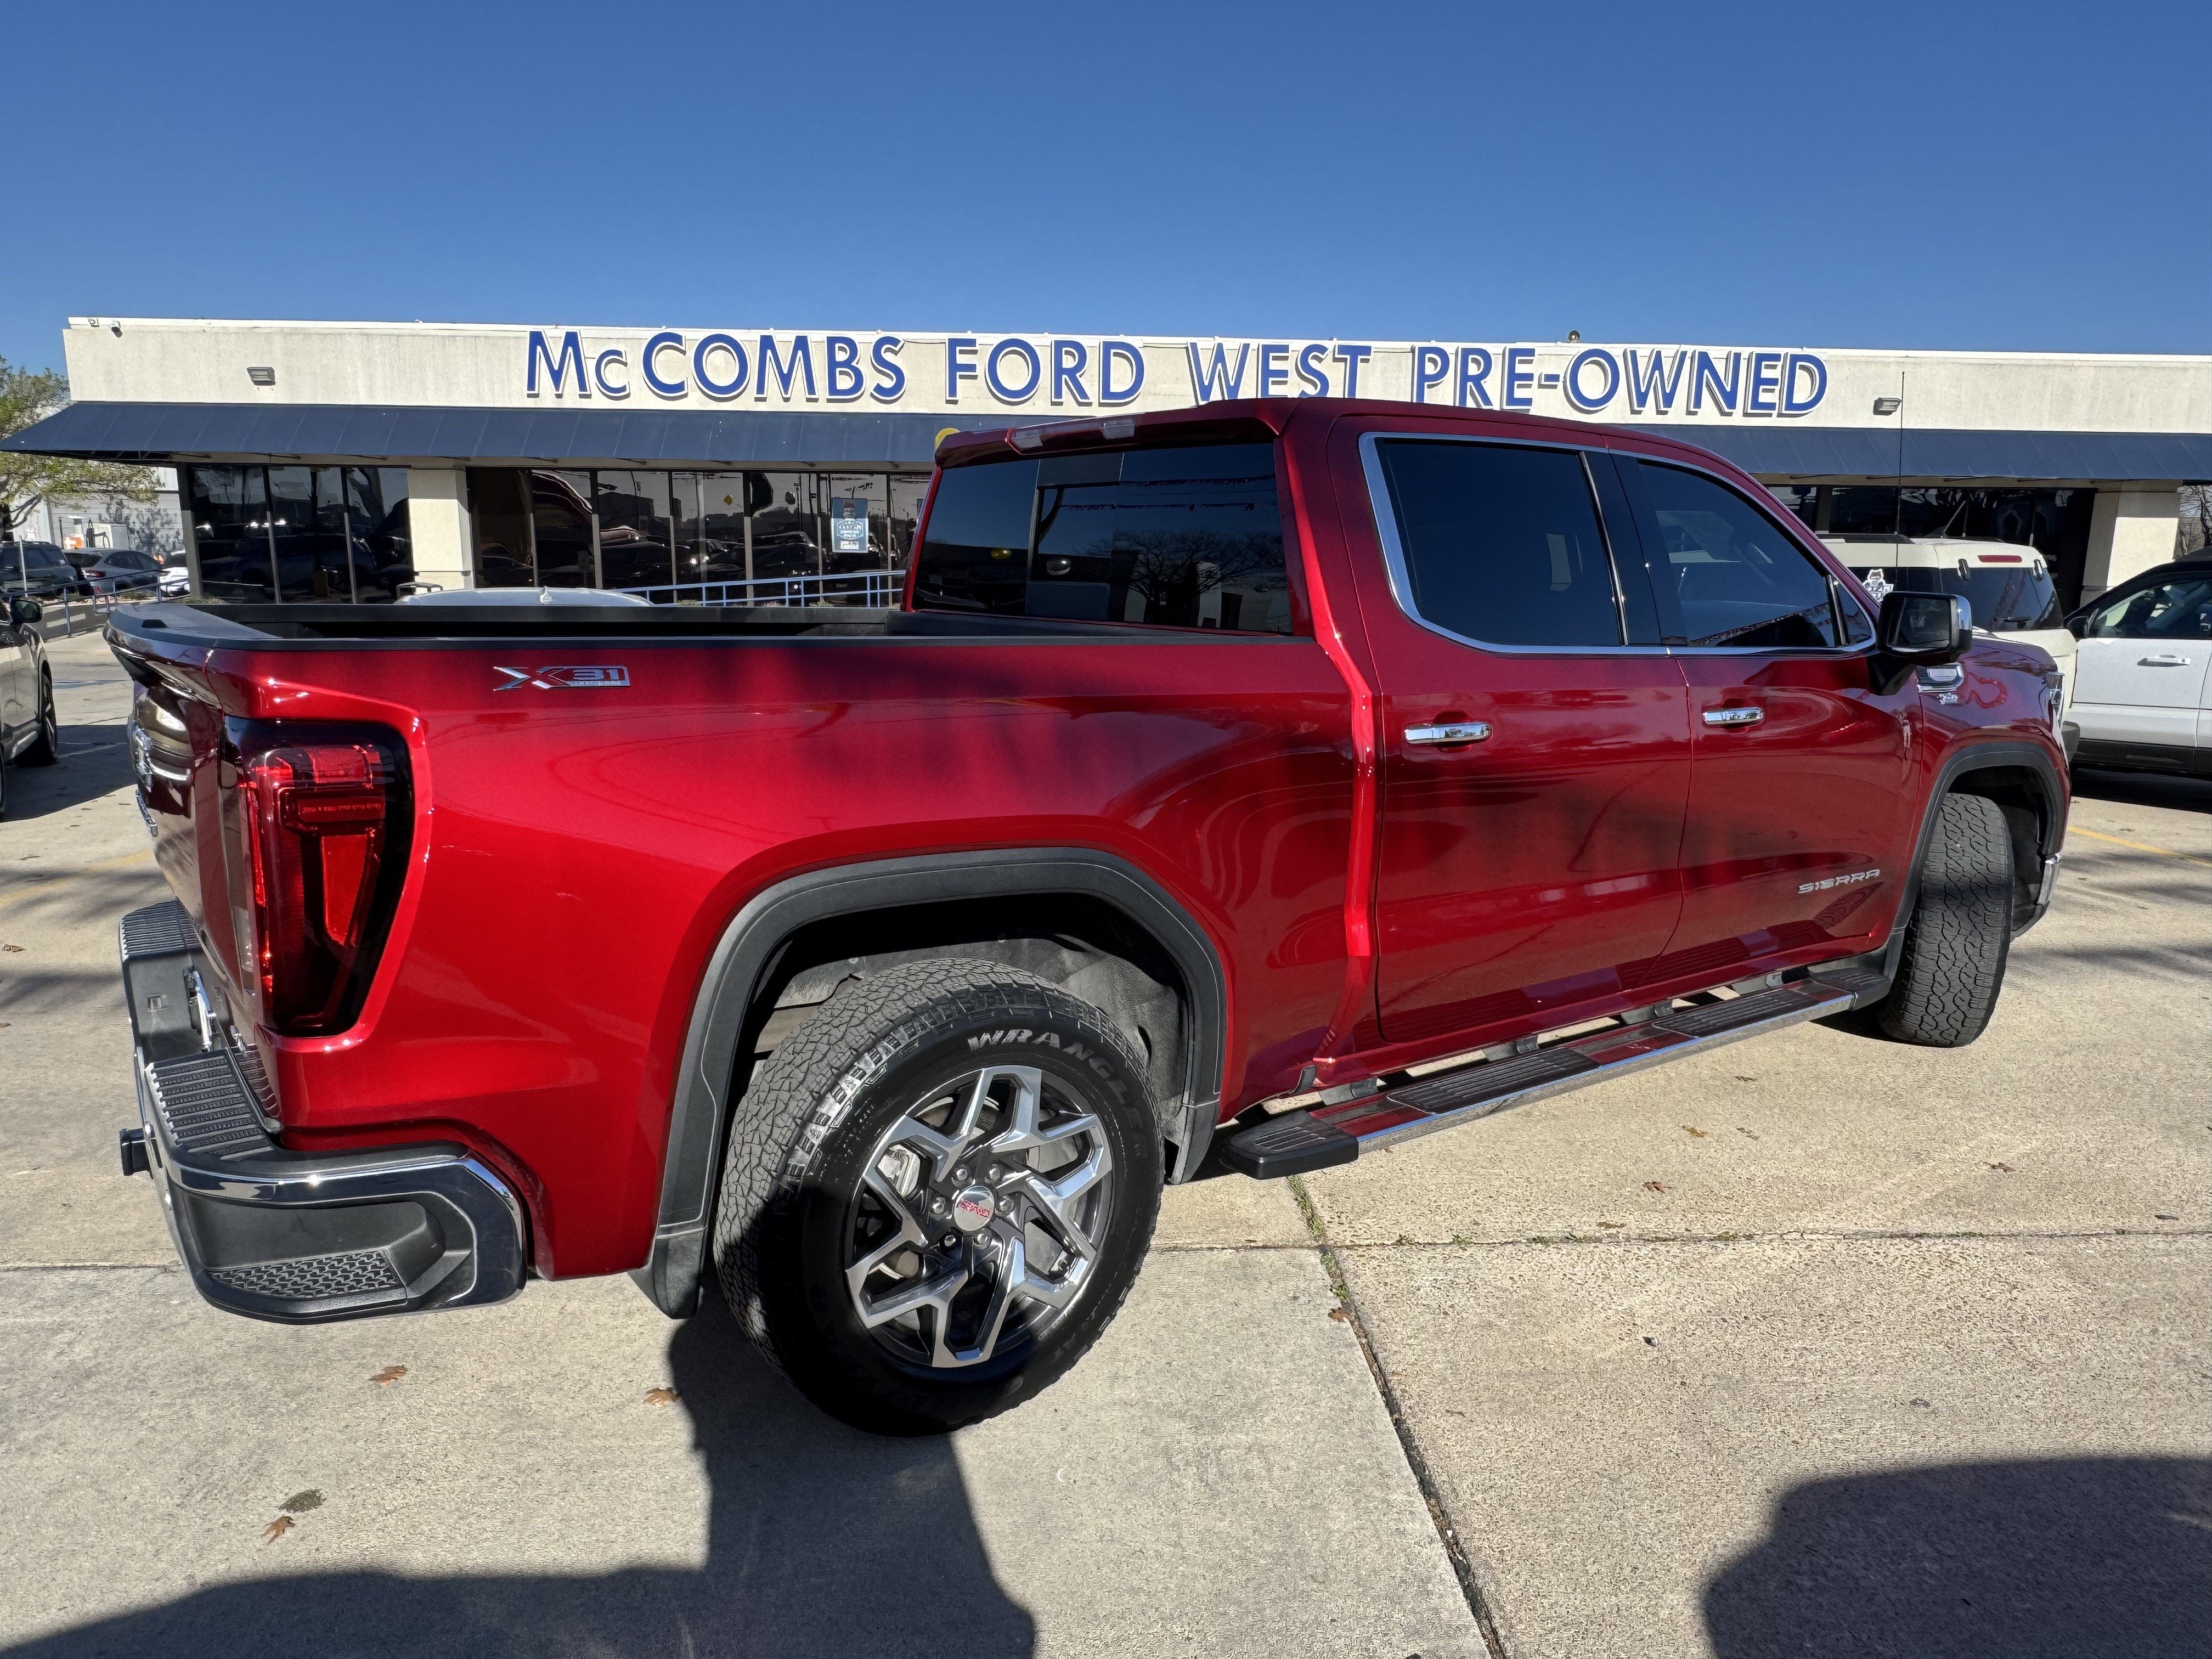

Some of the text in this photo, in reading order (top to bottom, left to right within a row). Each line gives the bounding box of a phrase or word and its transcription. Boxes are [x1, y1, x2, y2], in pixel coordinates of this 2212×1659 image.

[946, 337, 1146, 404] FORD
[1188, 341, 1373, 404] WEST
[1412, 345, 1829, 415] PRE-OWNED
[493, 665, 630, 691] X31
[1798, 869, 1880, 894] SIERRA
